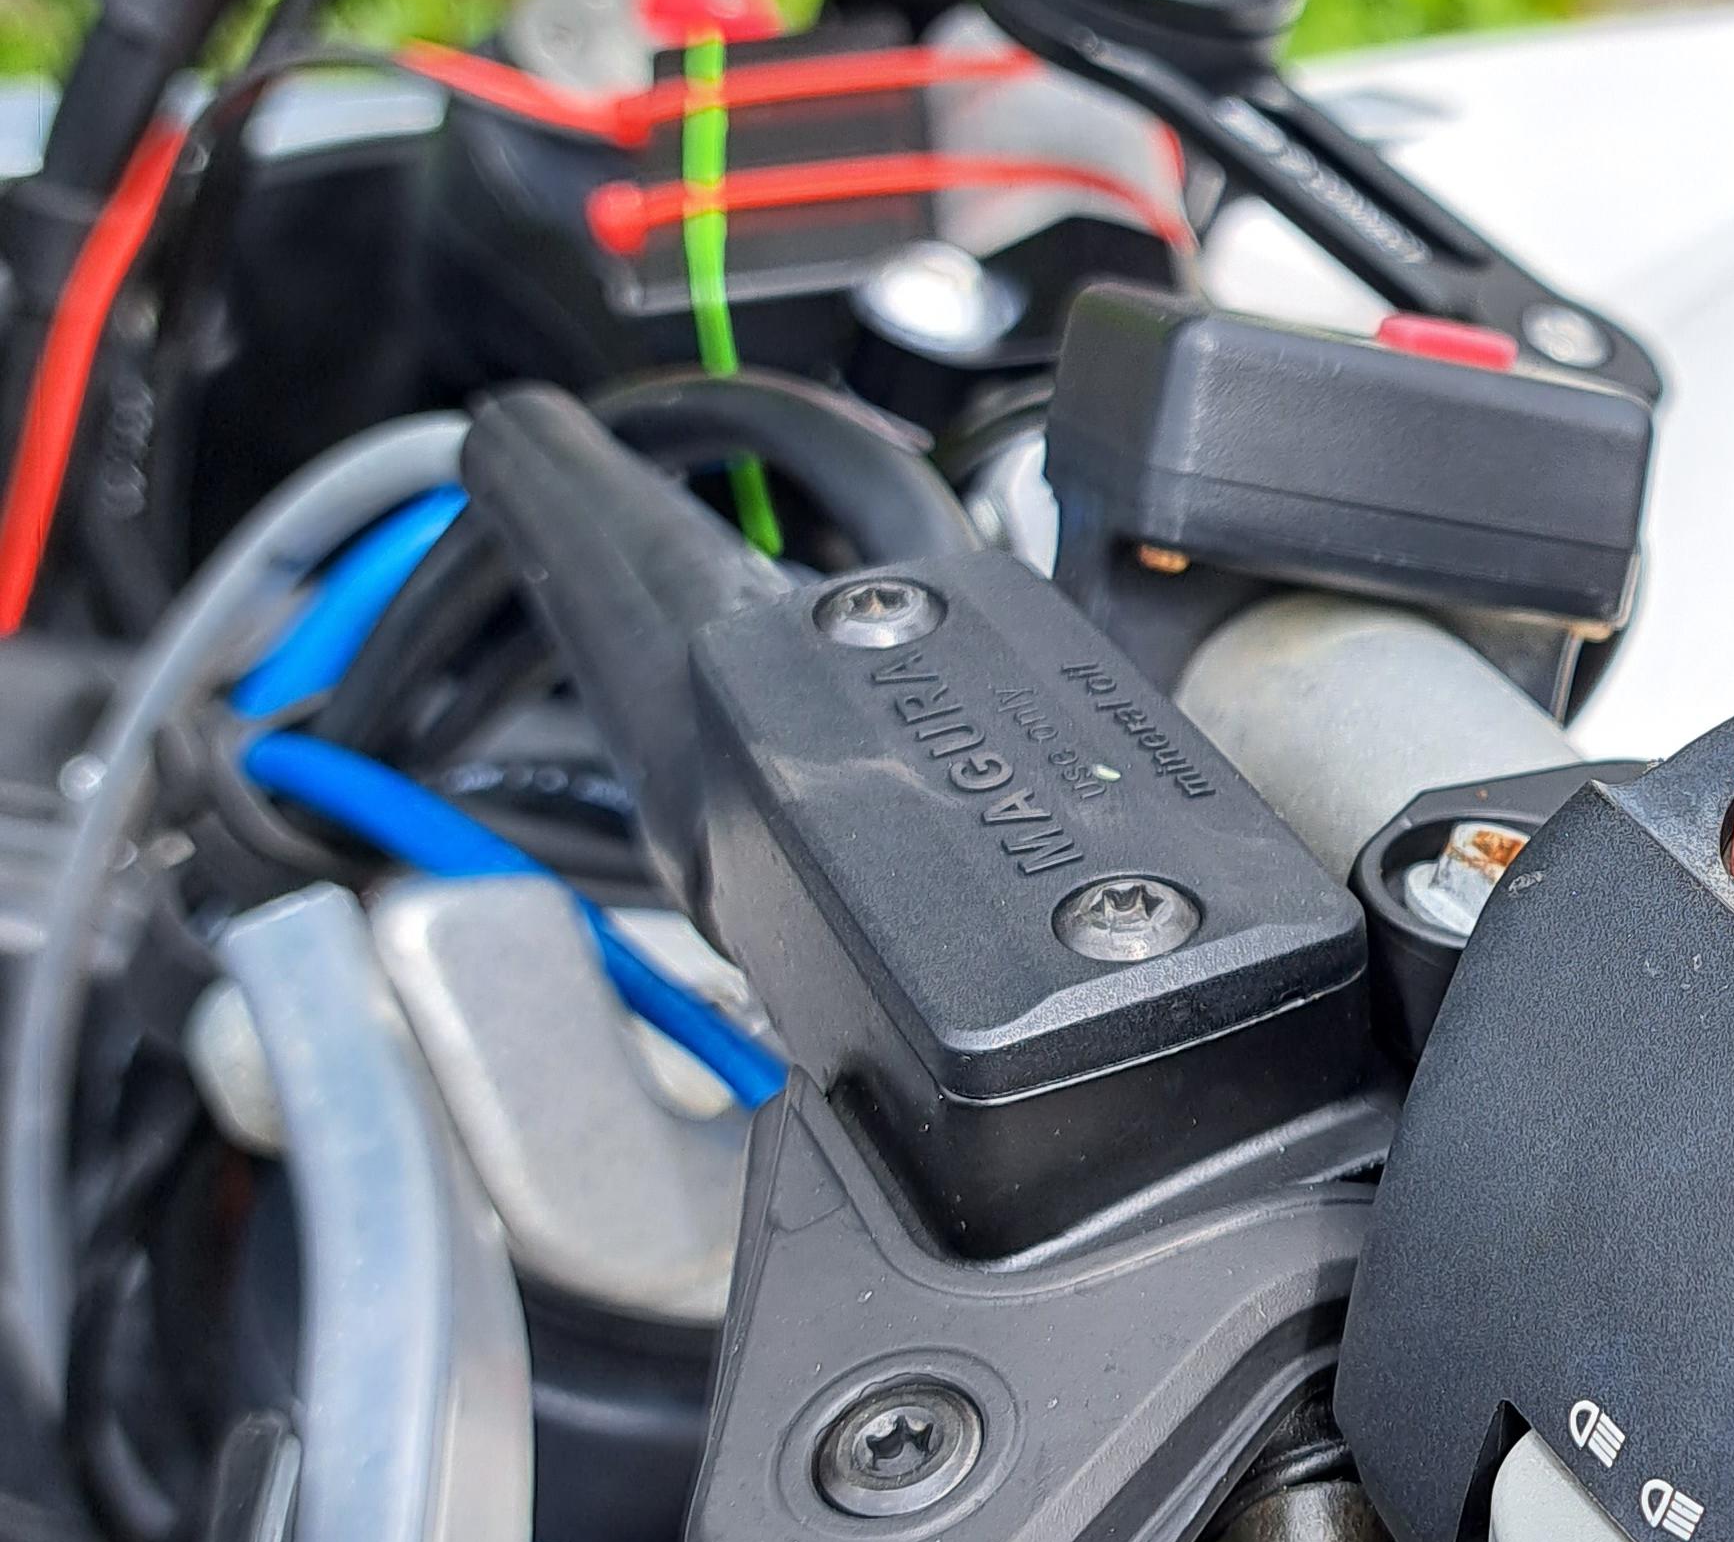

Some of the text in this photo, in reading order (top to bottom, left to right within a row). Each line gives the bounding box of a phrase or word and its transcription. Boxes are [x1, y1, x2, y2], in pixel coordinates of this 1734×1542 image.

[871, 651, 1084, 876] MAGURA
[996, 686, 1108, 801] use only
[1061, 661, 1217, 800] mineral oil
